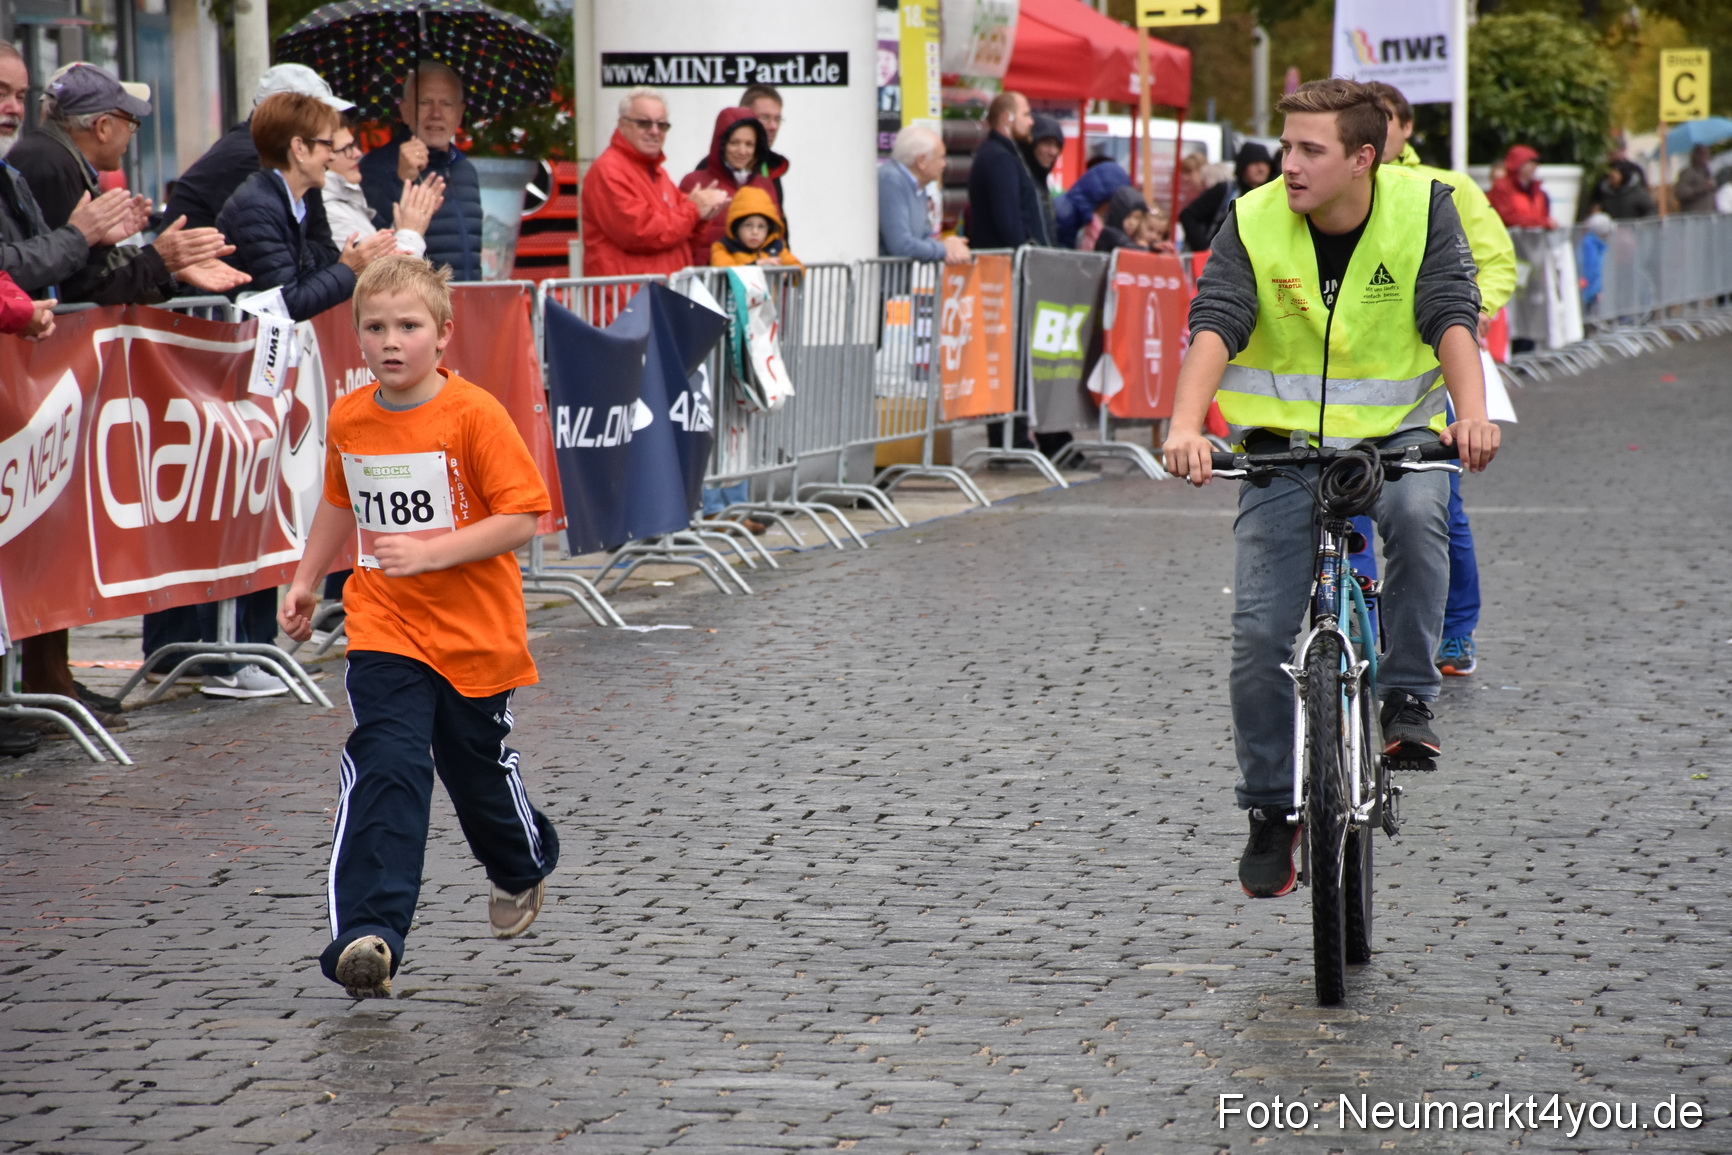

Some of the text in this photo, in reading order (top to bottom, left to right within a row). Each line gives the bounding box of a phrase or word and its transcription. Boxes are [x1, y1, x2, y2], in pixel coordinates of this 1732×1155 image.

[603, 56, 840, 83] www.MINI-Partl.de
[1673, 72, 1695, 104] C
[266, 326, 280, 368] swn
[23, 403, 73, 508] NEUE
[371, 465, 411, 477] BOCK
[359, 490, 434, 525] 7188
